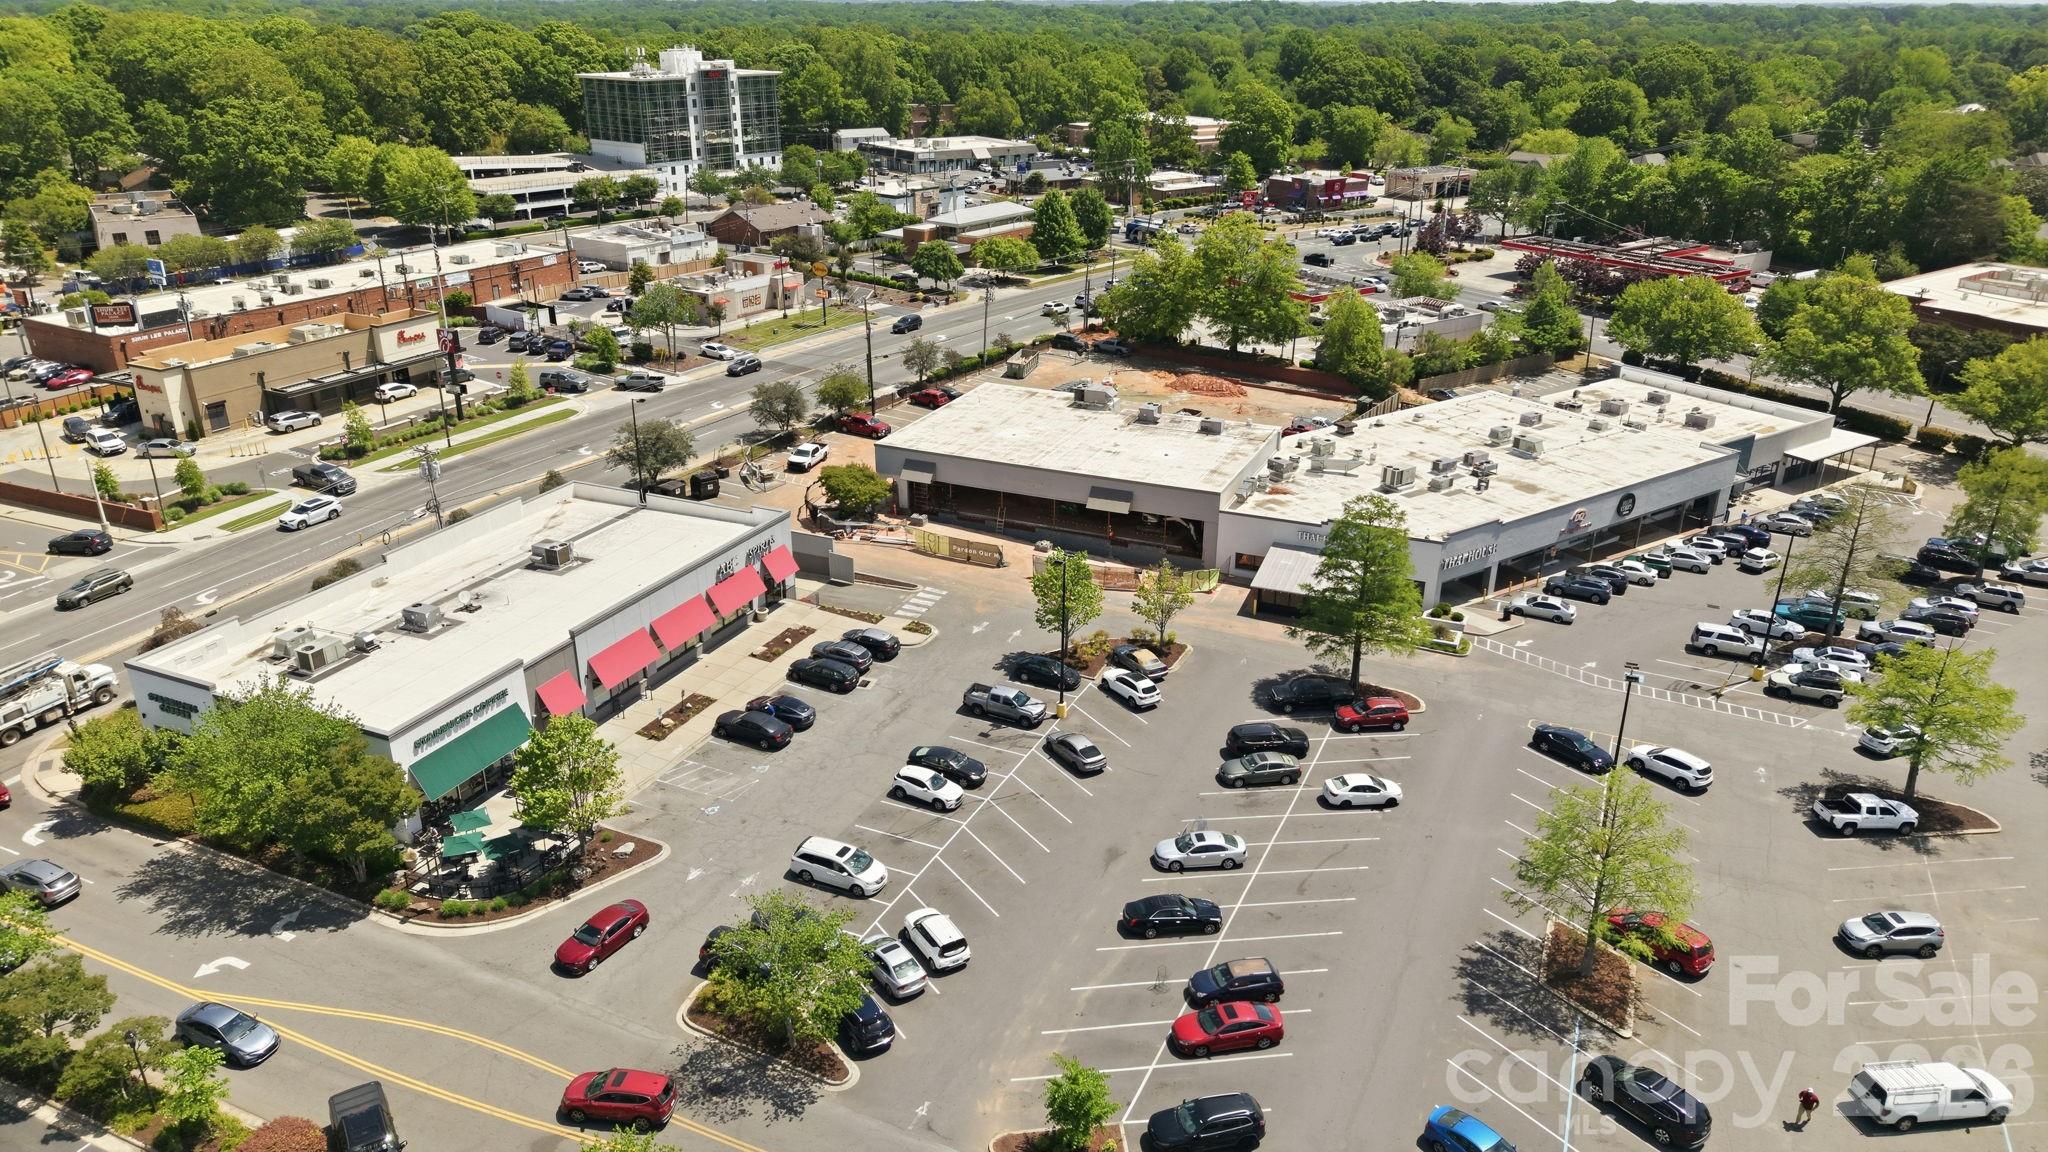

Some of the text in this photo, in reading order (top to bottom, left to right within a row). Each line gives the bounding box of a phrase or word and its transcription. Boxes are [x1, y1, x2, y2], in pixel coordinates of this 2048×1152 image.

[164, 328, 187, 336] PALACE
[953, 545, 976, 555] Pardon
[1468, 543, 1498, 563] HOUSE
[413, 688, 509, 749] STARBUCKS COFFEE
